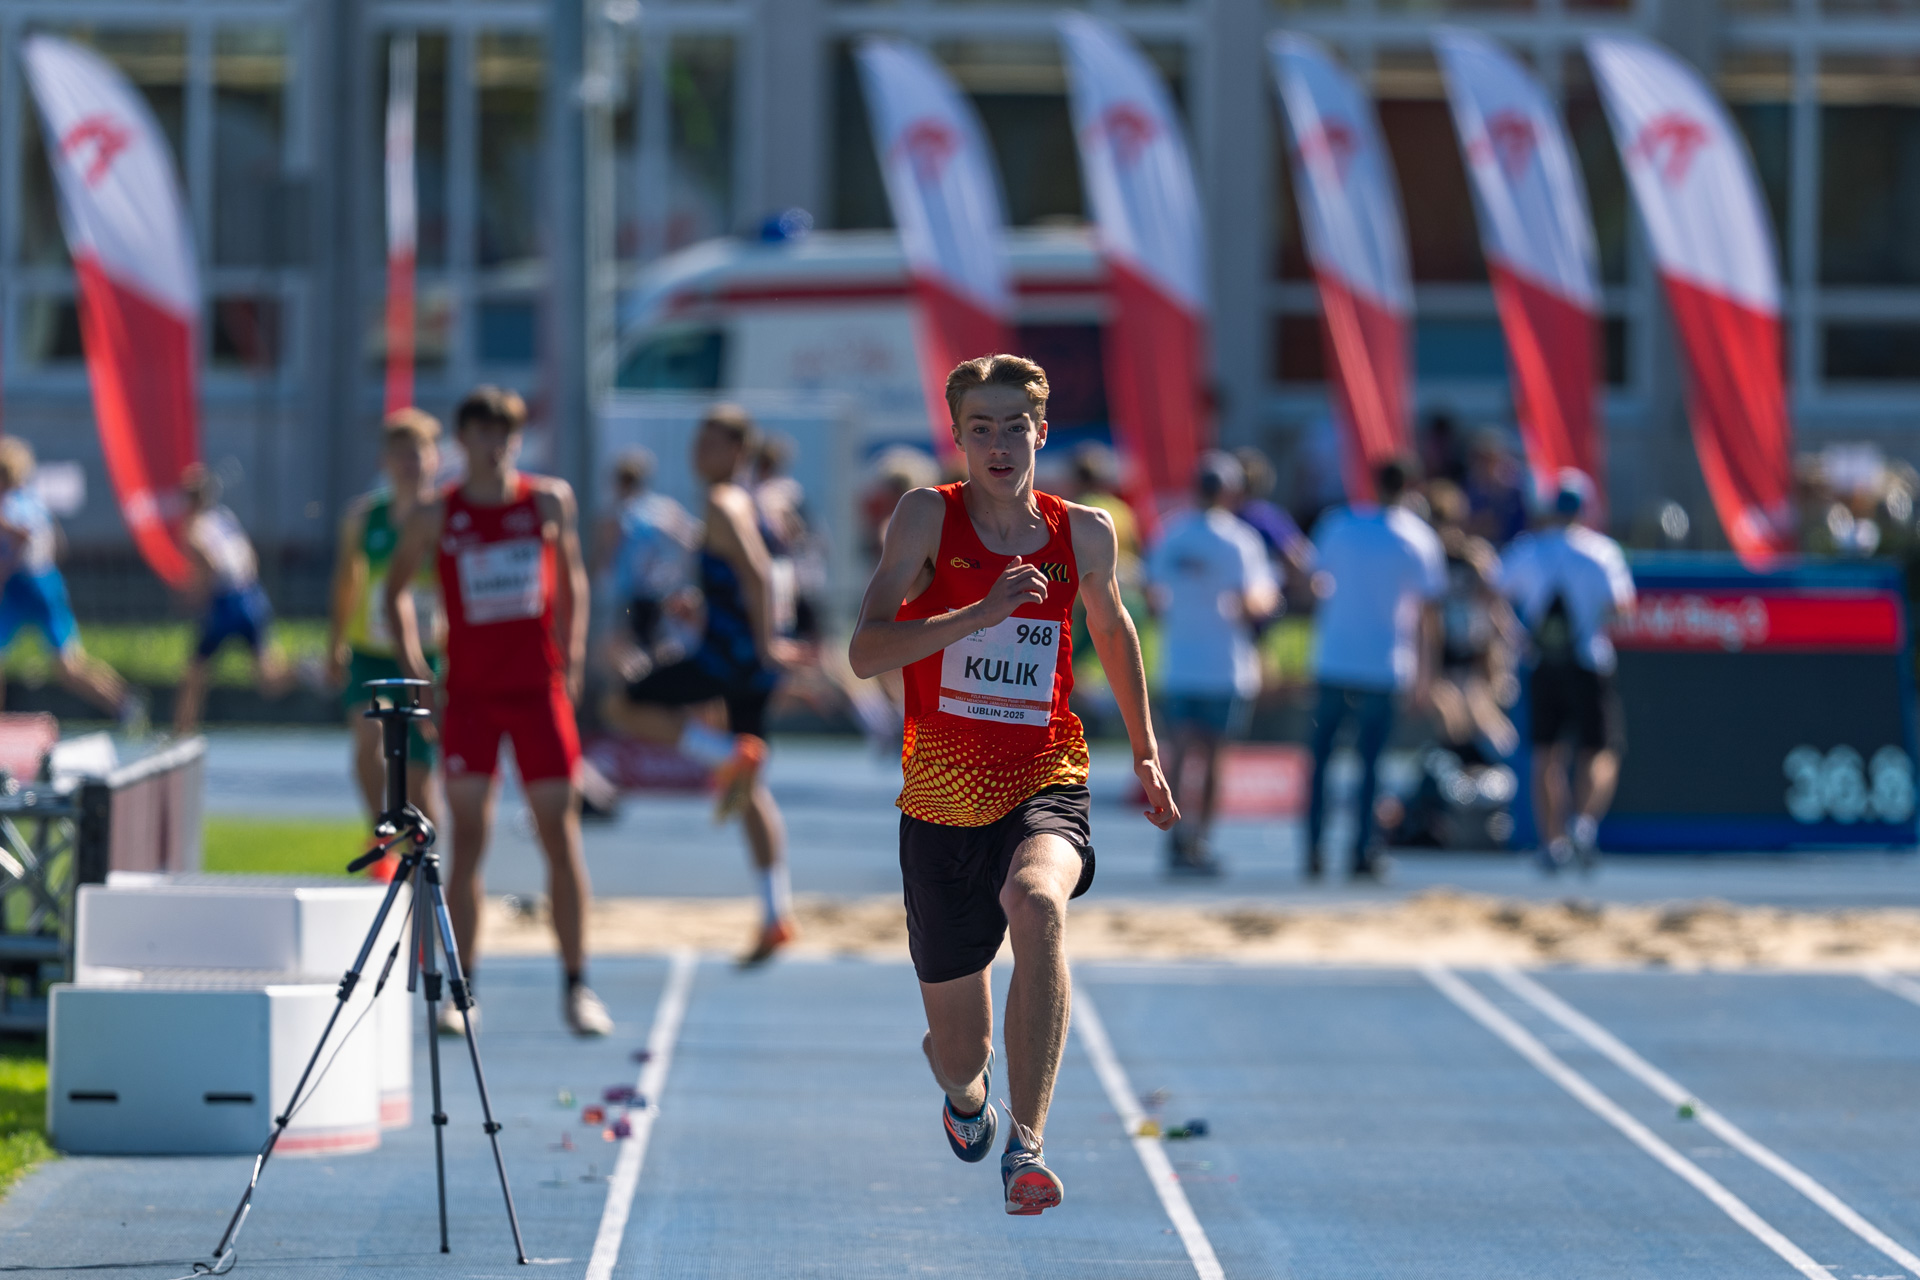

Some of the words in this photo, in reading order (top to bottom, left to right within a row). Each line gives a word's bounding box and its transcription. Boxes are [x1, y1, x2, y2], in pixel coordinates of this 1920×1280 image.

[1016, 624, 1053, 646] 968
[964, 656, 1039, 686] KULIK
[967, 705, 1001, 717] LUBLIN
[1002, 710, 1025, 720] 2025
